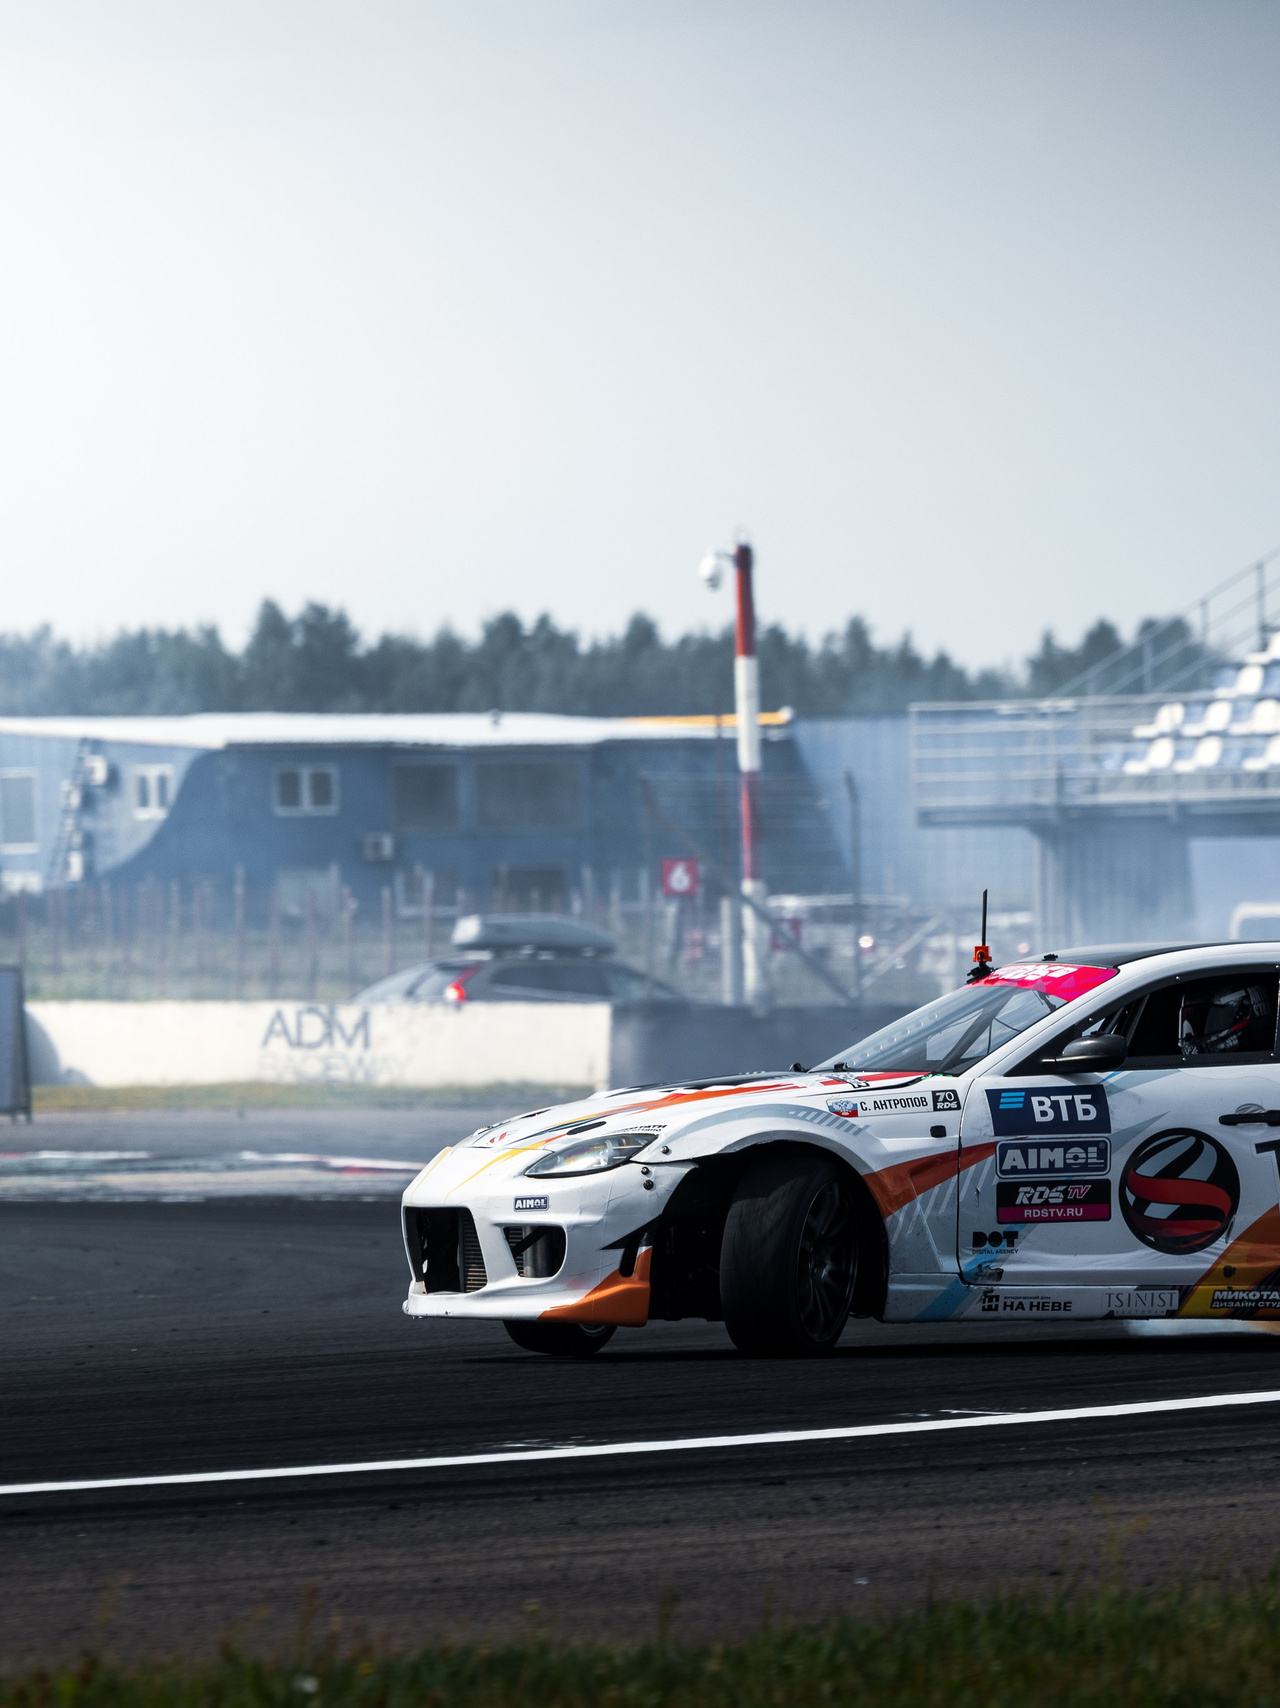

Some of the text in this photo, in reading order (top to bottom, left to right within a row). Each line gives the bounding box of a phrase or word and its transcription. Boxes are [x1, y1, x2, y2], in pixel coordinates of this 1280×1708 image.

[669, 861, 691, 892] 6
[261, 1005, 371, 1050] ADM
[873, 1096, 928, 1110] АНТРОПОВ
[935, 1091, 955, 1102] 70
[1030, 1094, 1097, 1122] ВТБ
[1001, 1146, 1105, 1170] AIMOL
[515, 1198, 546, 1209] AIMOL
[1024, 1207, 1083, 1218] RDSTV.RU
[972, 1230, 1019, 1248] DOT
[1002, 1301, 1073, 1312] НА НЕВЕ
[1105, 1292, 1177, 1308] TSINIST
